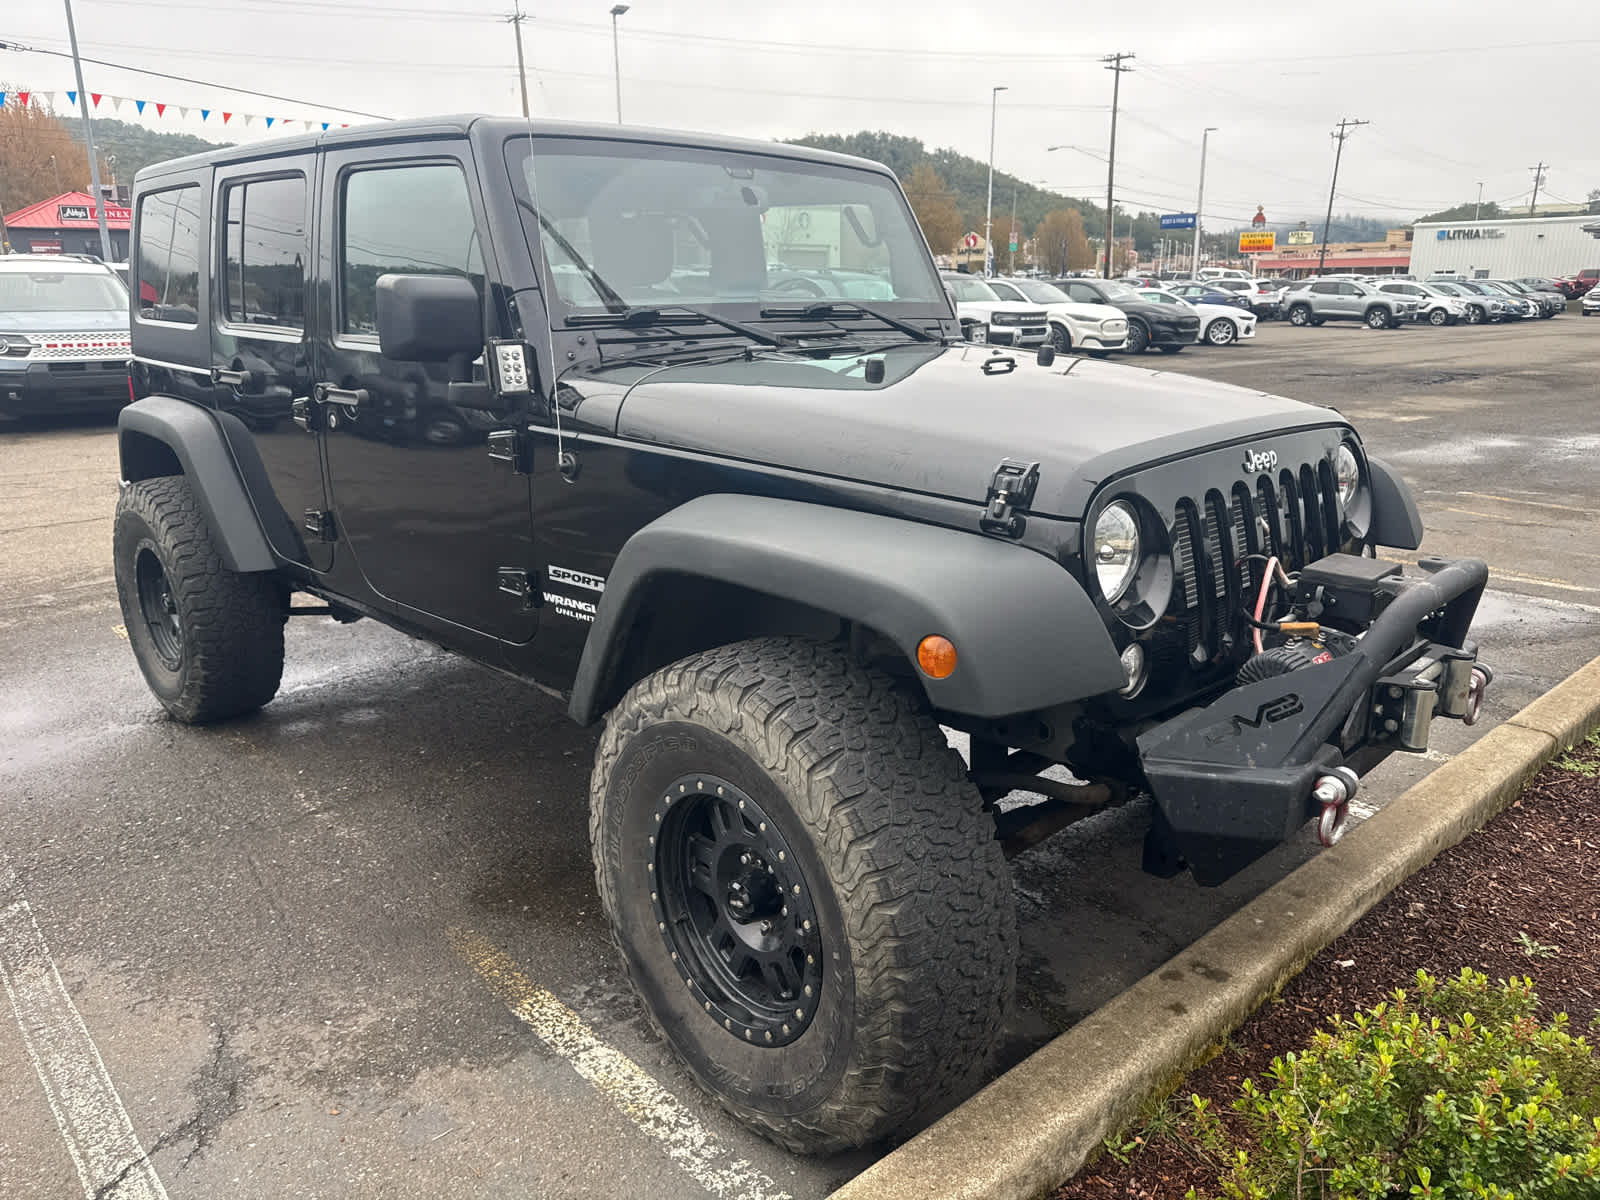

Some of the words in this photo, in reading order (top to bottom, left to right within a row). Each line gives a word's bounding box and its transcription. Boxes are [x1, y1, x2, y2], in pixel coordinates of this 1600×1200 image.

[94, 209, 130, 218] NEX
[1447, 229, 1481, 240] LITHIA
[1242, 448, 1279, 473] Jeep
[549, 568, 605, 589] SPORT
